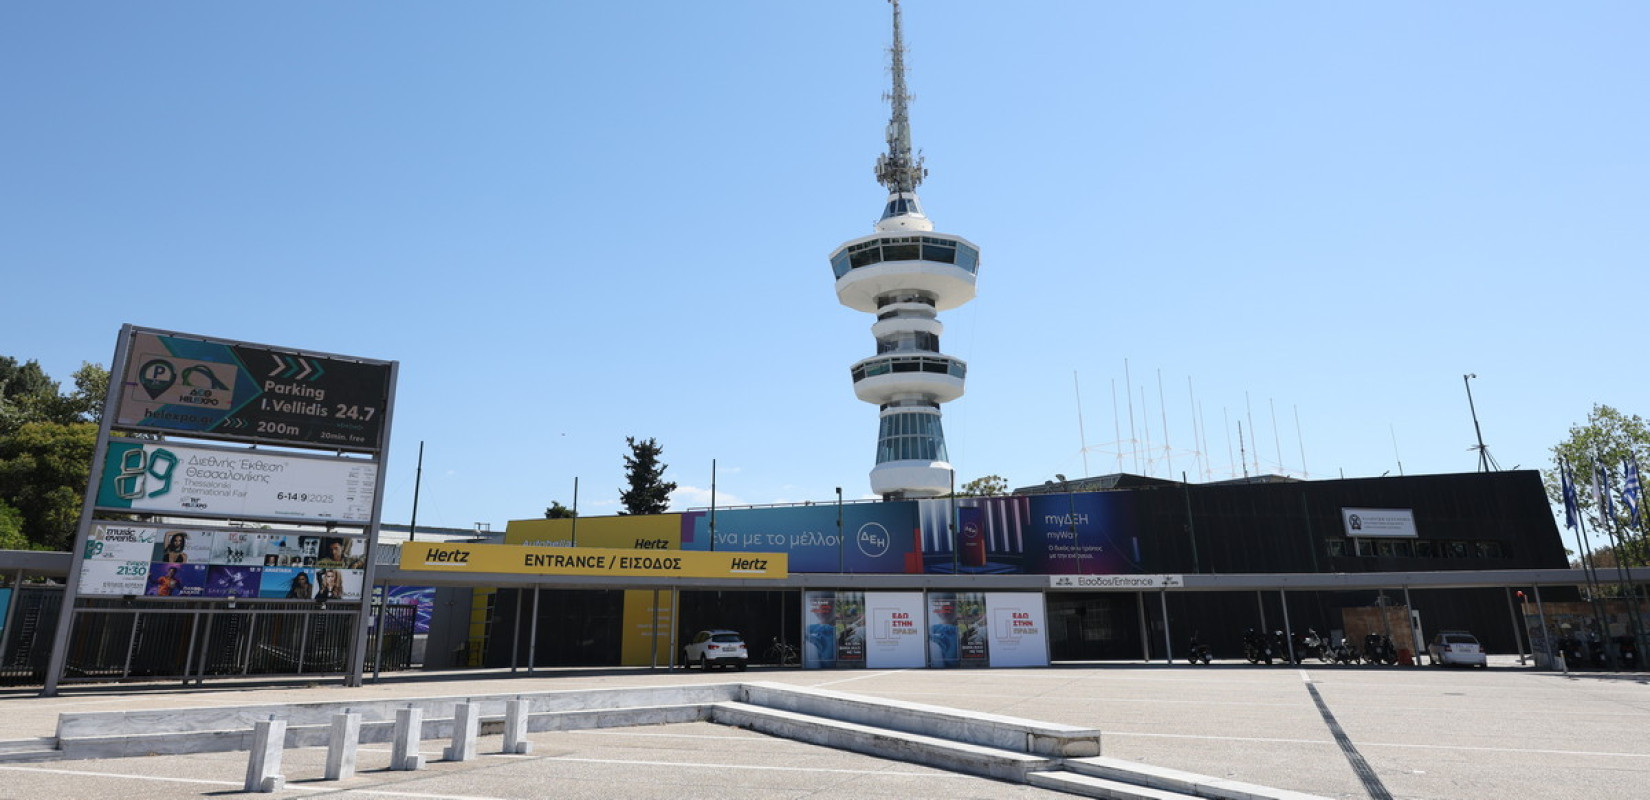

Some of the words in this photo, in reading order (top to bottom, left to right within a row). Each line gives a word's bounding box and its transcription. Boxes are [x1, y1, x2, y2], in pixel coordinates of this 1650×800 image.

[264, 380, 325, 400] Parking
[334, 404, 375, 421] 24.7
[257, 421, 300, 436] 200m
[349, 434, 366, 443] free
[188, 455, 236, 469] Διεθνής
[114, 448, 178, 500] 89
[186, 467, 270, 484] Θεσσαλονίκης
[184, 478, 231, 488] Thessaloniki
[182, 487, 230, 496] International
[106, 528, 136, 536] music
[634, 538, 669, 550] Hertz
[743, 534, 762, 548] με
[766, 533, 786, 545] το
[790, 532, 844, 548] μέλλον
[860, 532, 885, 548] ΔΕΗ
[426, 548, 470, 562] Hertz
[524, 554, 605, 568] ENTRANCE
[620, 558, 681, 570] ΕΙΣΟΔΟΣ
[116, 566, 146, 576] 21:30
[731, 558, 768, 570] Hertz
